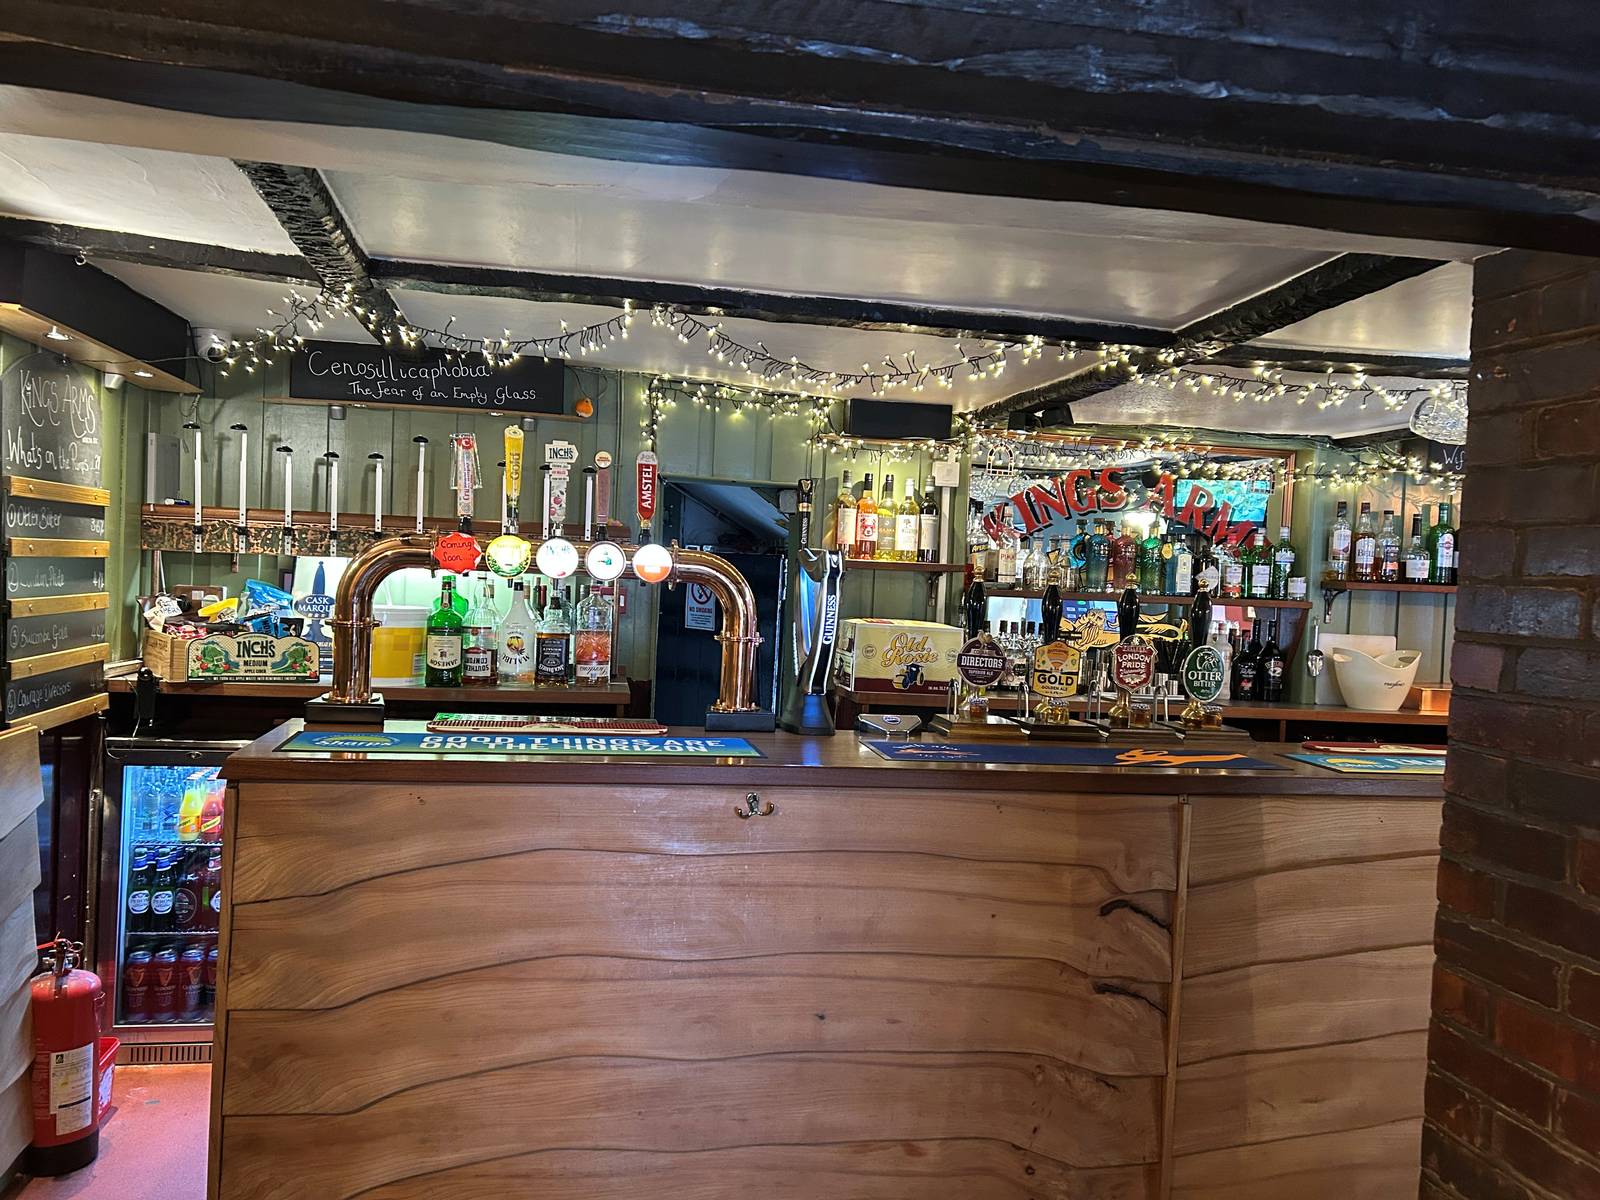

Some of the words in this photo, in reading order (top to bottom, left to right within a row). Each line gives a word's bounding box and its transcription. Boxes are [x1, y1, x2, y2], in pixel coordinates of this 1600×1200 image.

[349, 381, 374, 396] The
[372, 381, 406, 400] Fear
[411, 387, 425, 401] of
[429, 388, 449, 399] an
[453, 387, 488, 403] Empty
[493, 386, 537, 405] Glass
[7, 426, 42, 470] What's
[45, 450, 58, 470] on
[1442, 446, 1465, 470] Wif
[641, 465, 653, 509] AMSTEL
[800, 517, 808, 545] GUINNESS
[440, 540, 473, 552] Coming
[305, 596, 329, 605] CASK
[298, 604, 332, 612] MARQU
[822, 594, 837, 645] GUINNESS
[236, 639, 275, 658] INCH'S
[889, 633, 929, 653] Old
[429, 658, 458, 668] JAMESON
[880, 647, 939, 668] Rosie
[961, 655, 1003, 668] DIRECTORS
[1117, 653, 1151, 663] LONDON
[464, 664, 490, 672] SOUTHER
[1120, 661, 1146, 669] PRIDE
[1037, 673, 1074, 686] GOLD
[1188, 671, 1222, 681] OTTER
[1193, 680, 1216, 688] BITTER
[421, 736, 514, 745] GOOD
[527, 737, 649, 747] THINGS
[663, 738, 726, 747] ARE
[485, 742, 549, 750] THE
[562, 743, 710, 752] HORIZON
